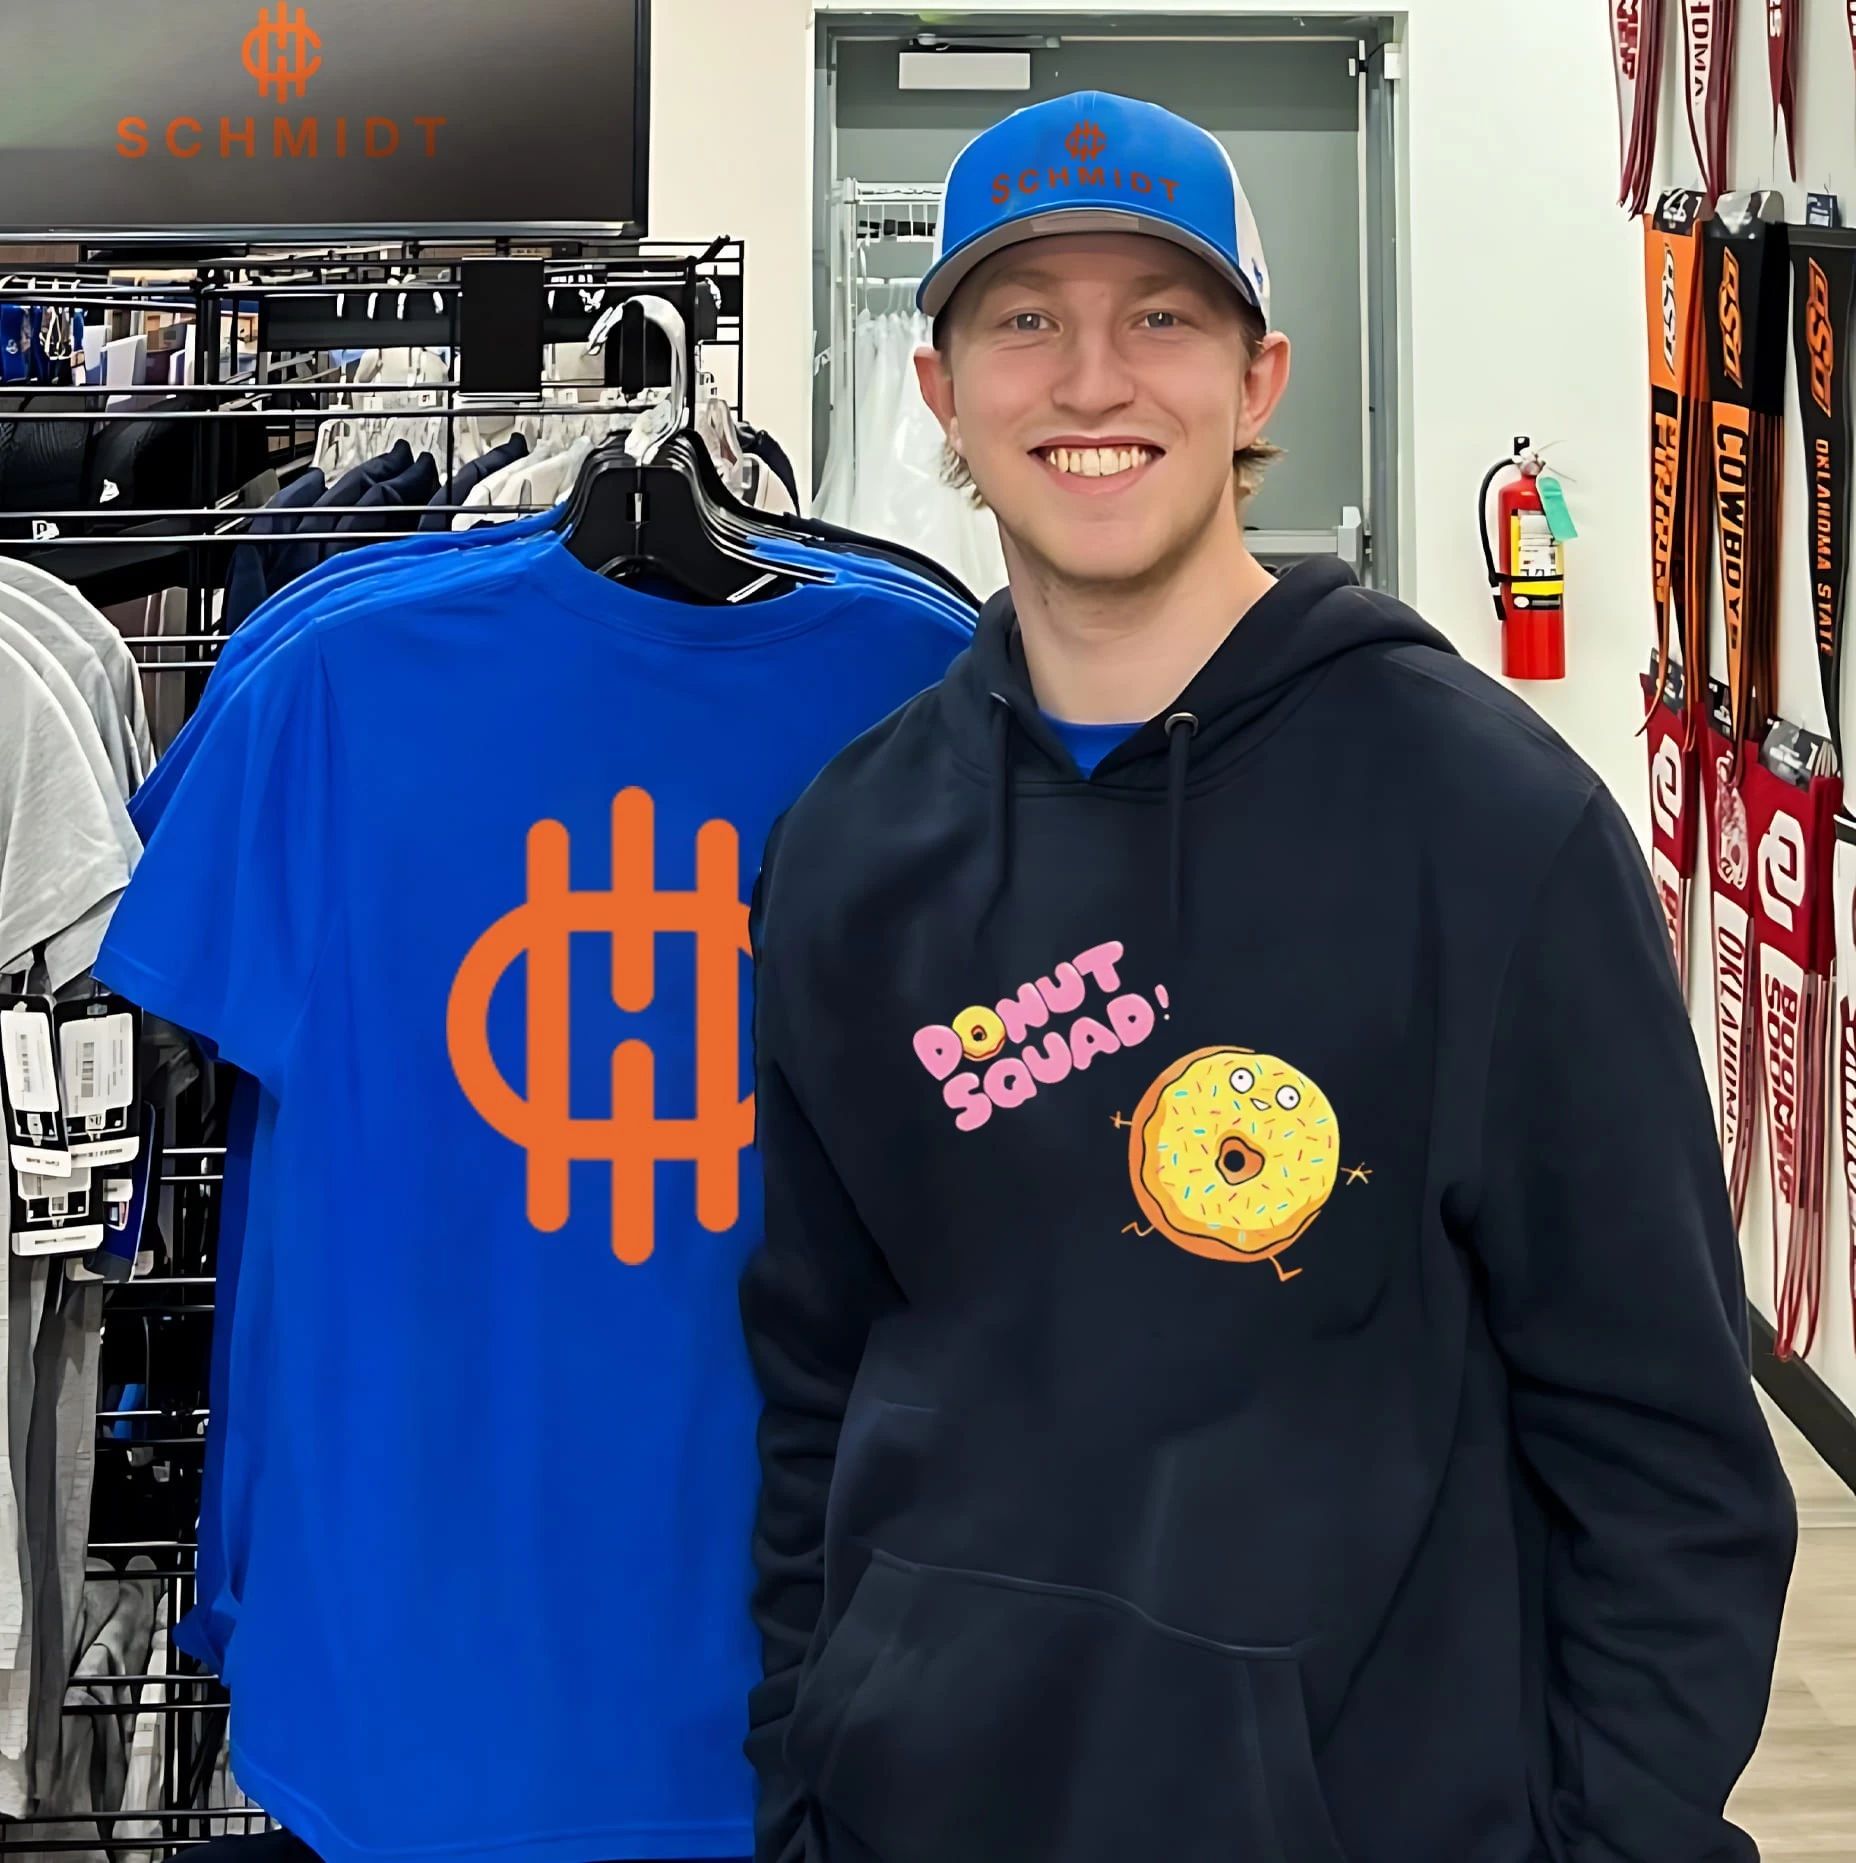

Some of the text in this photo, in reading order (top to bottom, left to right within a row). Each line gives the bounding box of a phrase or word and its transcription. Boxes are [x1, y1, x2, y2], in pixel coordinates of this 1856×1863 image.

[115, 116, 447, 159] SCHMIDT
[991, 166, 1180, 205] SCHMIDT
[1815, 438, 1832, 570] OKLAHOMA
[912, 940, 1124, 1081] DONUT
[942, 984, 1170, 1132] SQUAD!
[1717, 926, 1745, 1144] OKLAHOMA
